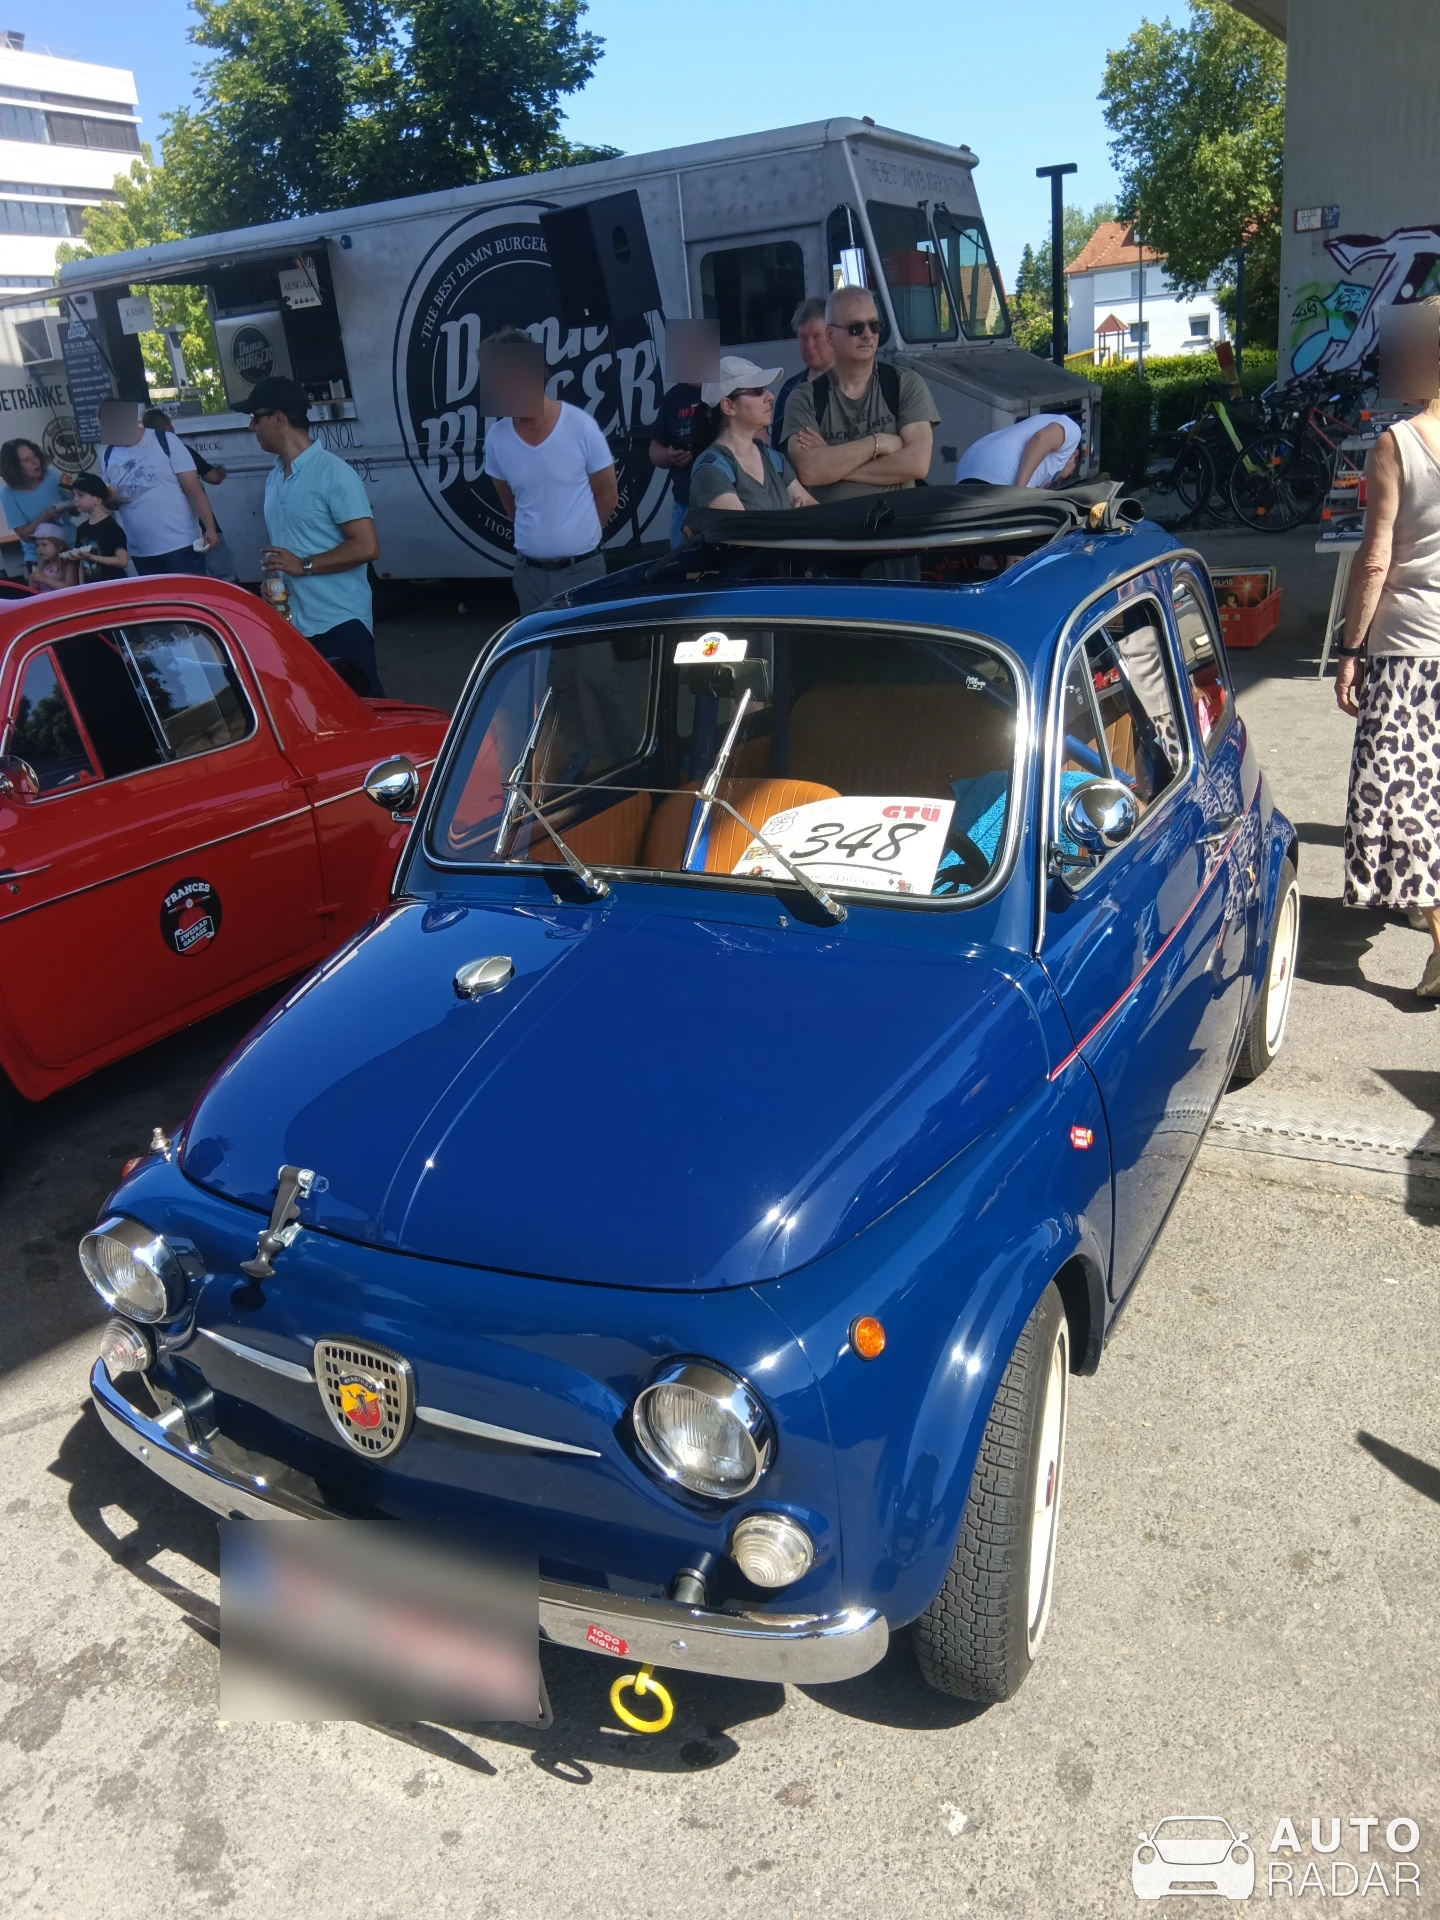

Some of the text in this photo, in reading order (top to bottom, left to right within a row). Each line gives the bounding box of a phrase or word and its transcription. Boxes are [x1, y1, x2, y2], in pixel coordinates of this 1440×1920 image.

[421, 235, 548, 339] THE BEST DAMN BURGER
[125, 307, 145, 318] KASSE
[0, 384, 66, 413] ETRÄNKE
[882, 805, 942, 823] GTÜ
[789, 822, 927, 862] 348
[164, 882, 211, 907] FRANCES
[180, 919, 208, 941] ZWEIRAD
[183, 927, 208, 946] GARAGE
[587, 1634, 620, 1654] MIGLIA
[592, 1628, 620, 1645] 1000
